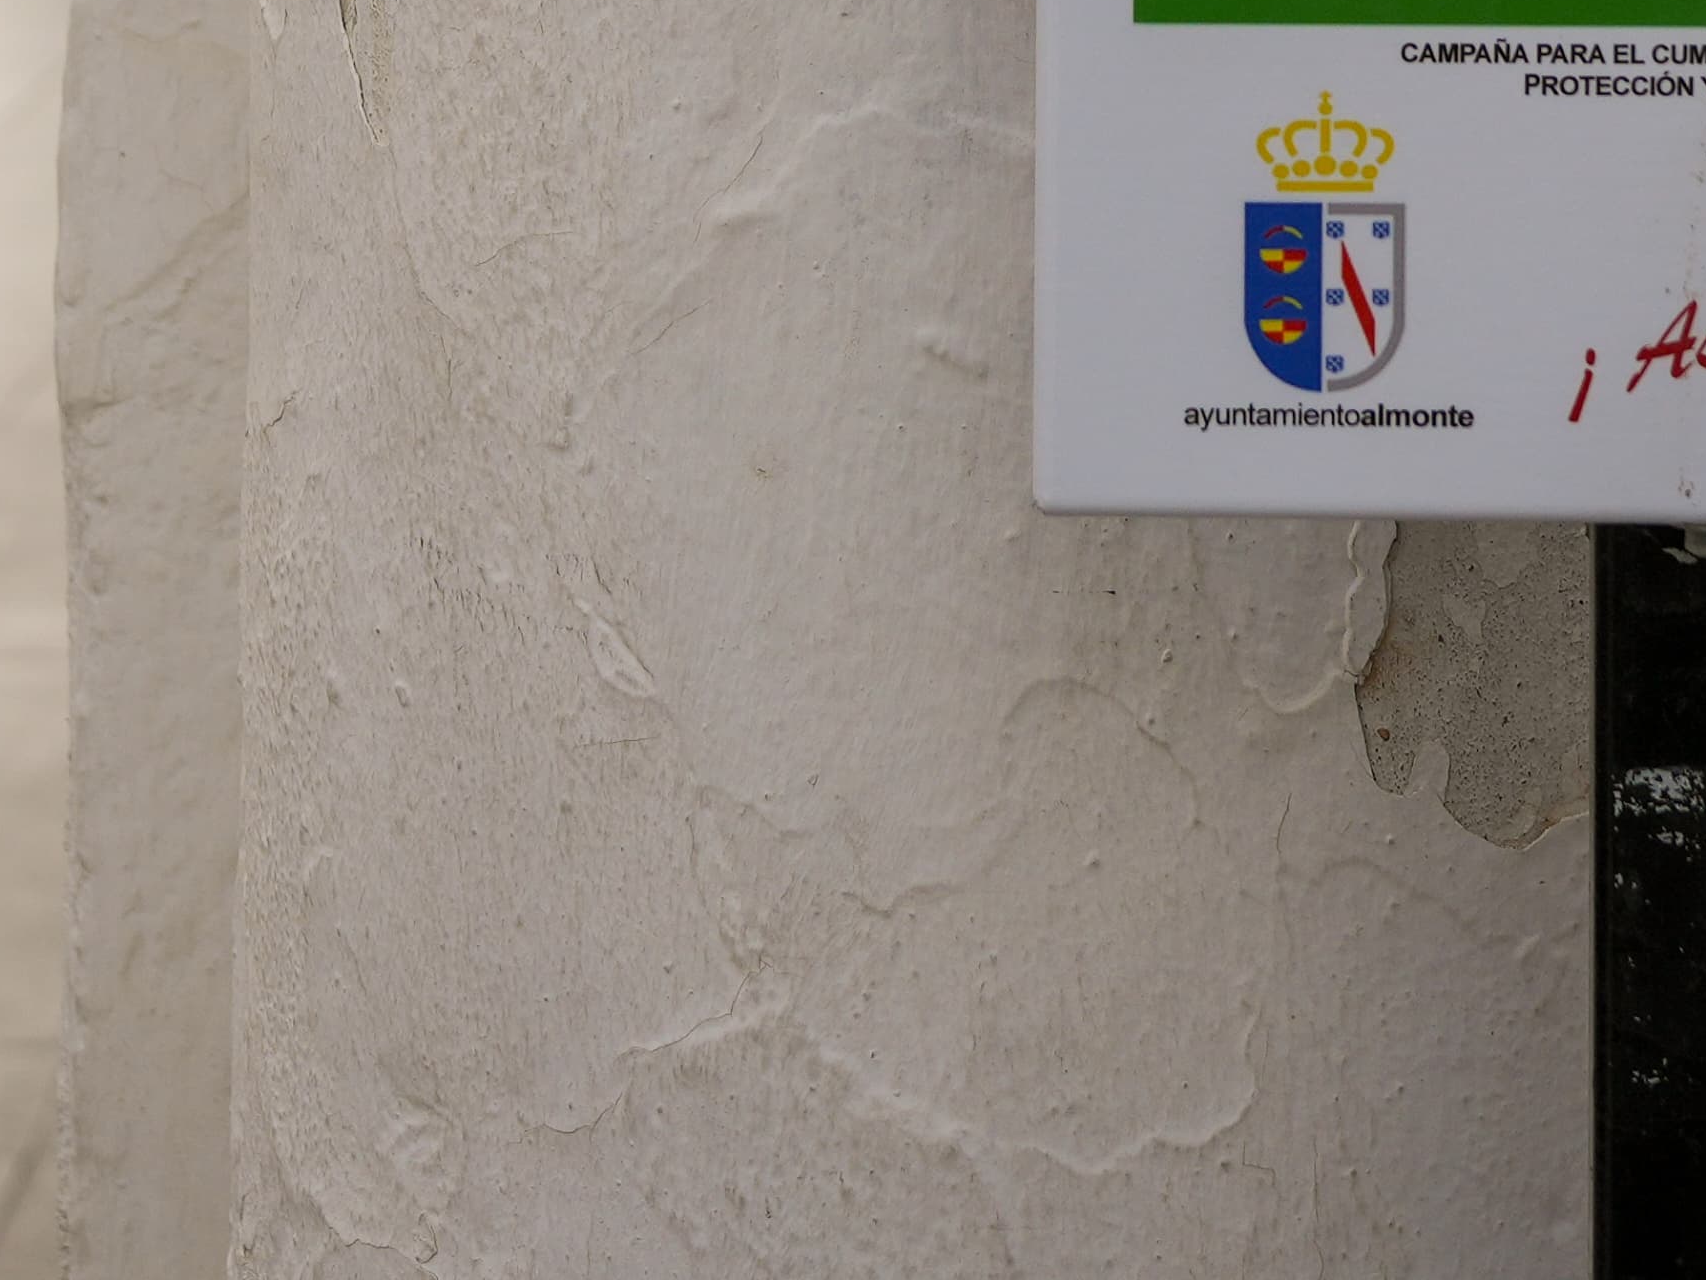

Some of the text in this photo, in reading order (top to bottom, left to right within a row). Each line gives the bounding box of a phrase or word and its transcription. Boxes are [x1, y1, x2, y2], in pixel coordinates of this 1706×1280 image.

[1400, 38, 1530, 65] CAMPAÑA
[1536, 43, 1607, 65] PARA
[1612, 43, 1646, 65] EL
[1524, 70, 1695, 98] PROTECCIÓN
[1183, 402, 1476, 433] ayuntamientoalmonte
